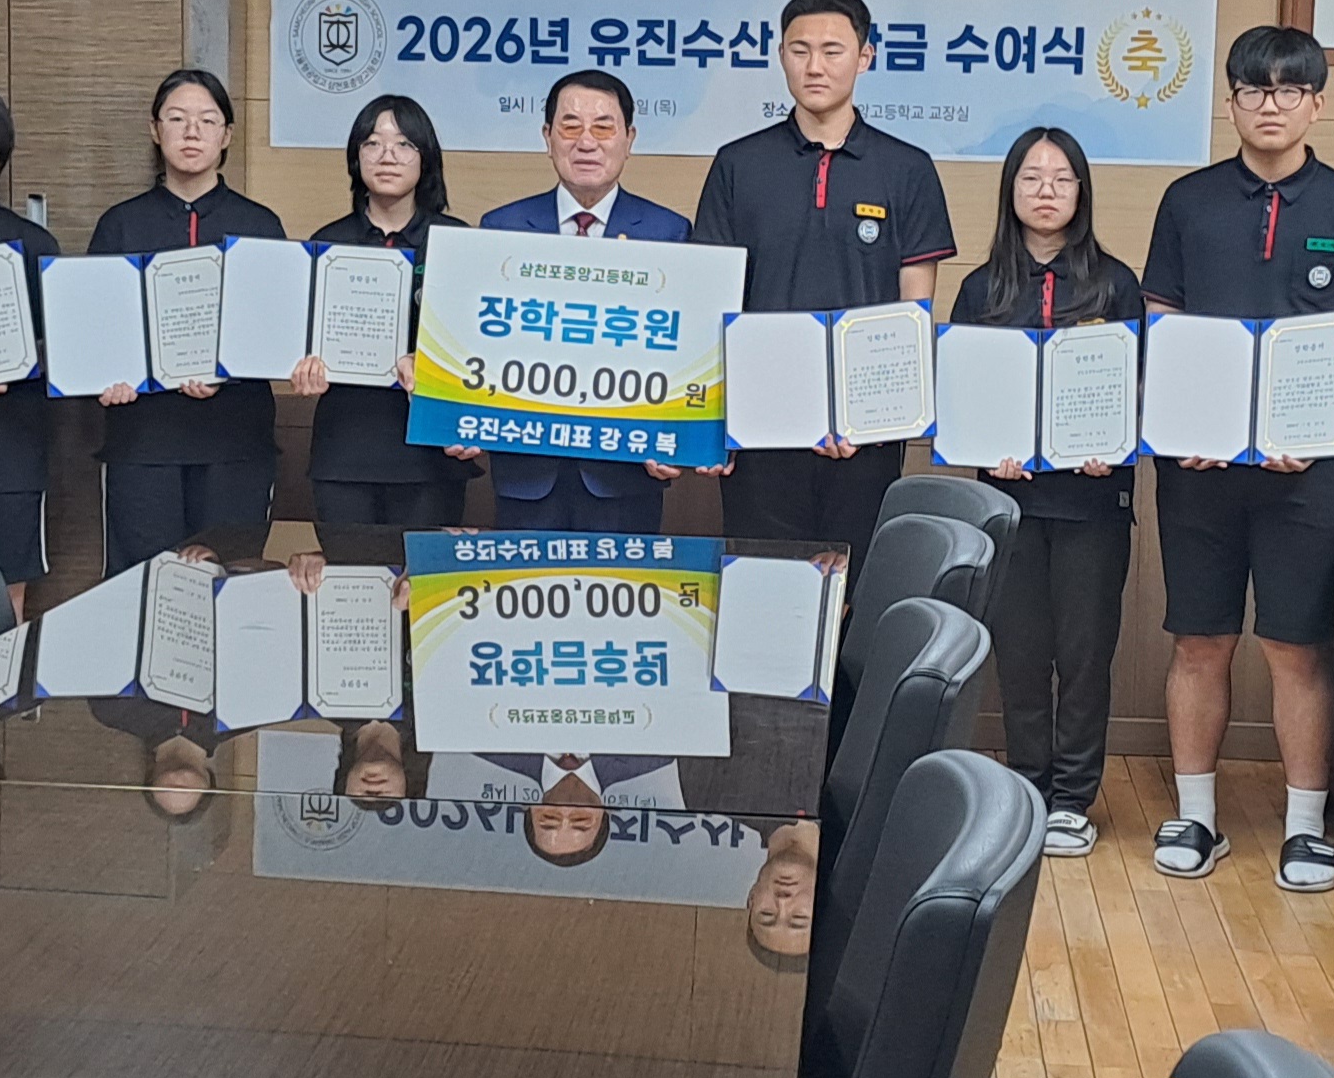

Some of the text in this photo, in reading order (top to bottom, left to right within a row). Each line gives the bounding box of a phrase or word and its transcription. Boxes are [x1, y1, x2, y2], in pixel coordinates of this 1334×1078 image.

[396, 15, 569, 65] 2026년
[588, 18, 774, 68] 유진수산
[945, 23, 1085, 75] 수여식
[1121, 29, 1167, 80] 축
[499, 97, 525, 113] 일시
[653, 99, 677, 116] (목)
[762, 102, 789, 118] 장소
[928, 105, 969, 122] 교장실
[519, 262, 649, 286] 삼천포중앙고등학교
[478, 295, 681, 351] 장학금후원
[462, 357, 707, 409] 3,000,000 원
[457, 416, 678, 457] 유진수산 대표 강 유 복
